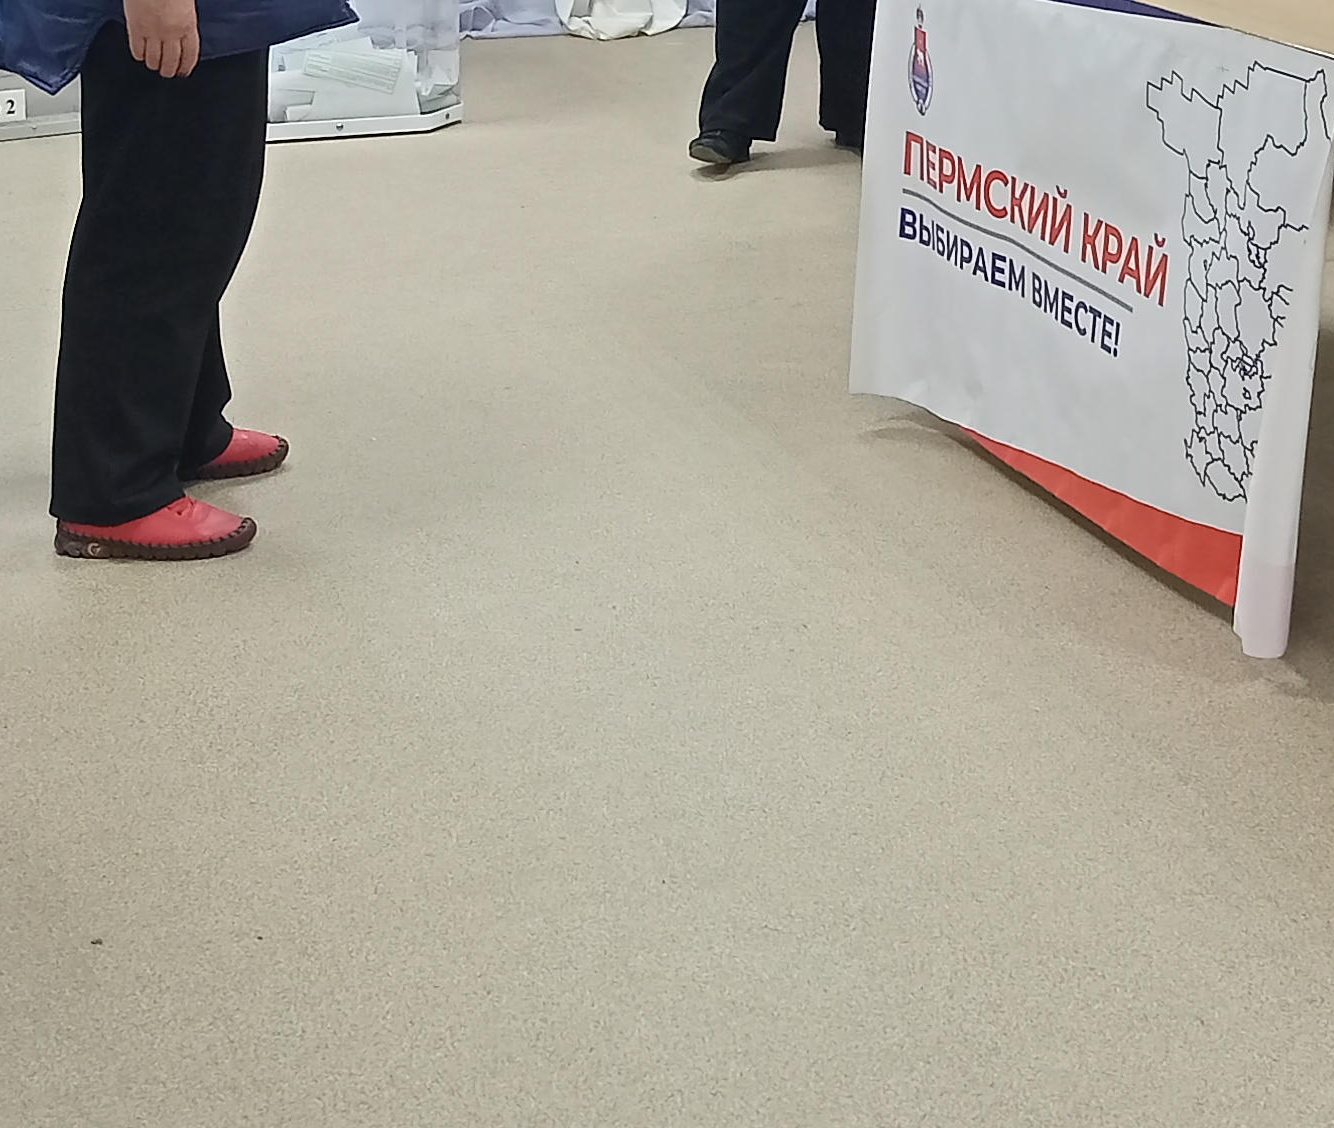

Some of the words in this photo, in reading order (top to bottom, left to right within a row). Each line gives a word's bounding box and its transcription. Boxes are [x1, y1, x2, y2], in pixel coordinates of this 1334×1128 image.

[6, 99, 16, 115] 2
[898, 207, 1025, 298] ВЫБИРАЕМ
[1031, 271, 1121, 357] ВМЕСТЕ!
[903, 131, 1072, 254] ПЕРМСКИЙ
[1081, 212, 1169, 307] КРАЙ
